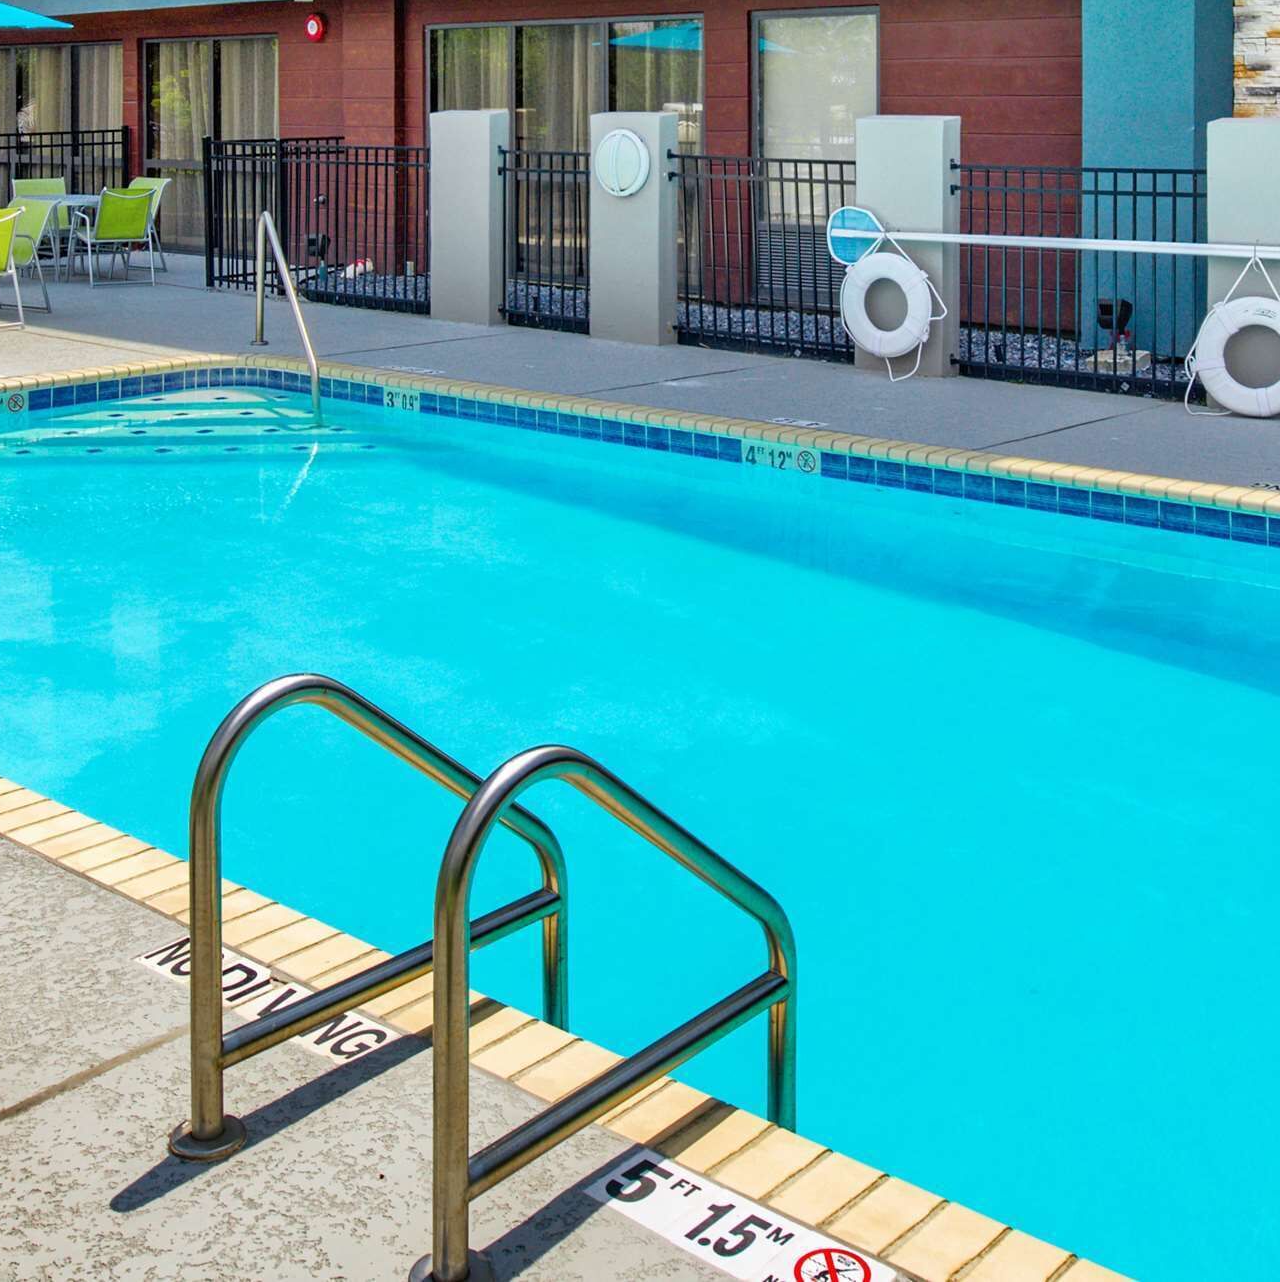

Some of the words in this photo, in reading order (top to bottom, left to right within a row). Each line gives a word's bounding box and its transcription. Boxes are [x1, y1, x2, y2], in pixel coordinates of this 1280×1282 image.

[387, 391, 395, 408] 3
[745, 445, 757, 465] 4
[222, 962, 388, 1060] DIVNG
[605, 1159, 674, 1203] 5
[670, 1178, 702, 1198] FT
[684, 1203, 773, 1258] 1.5
[765, 1226, 795, 1246] M
